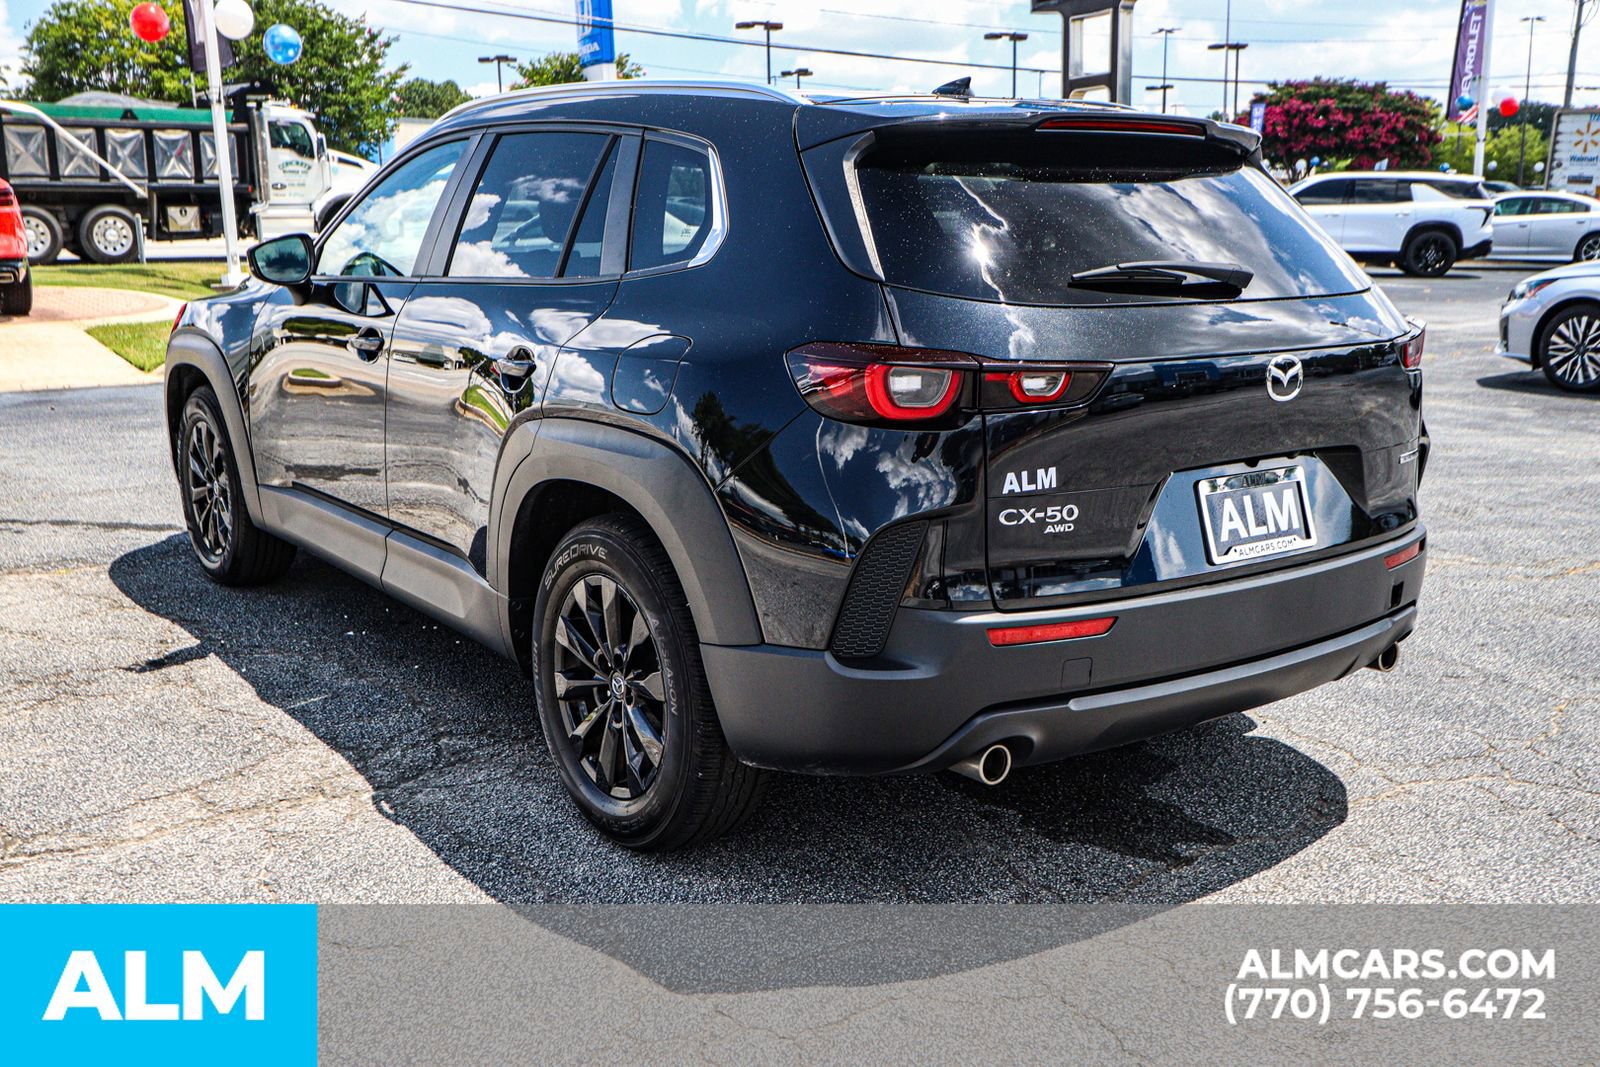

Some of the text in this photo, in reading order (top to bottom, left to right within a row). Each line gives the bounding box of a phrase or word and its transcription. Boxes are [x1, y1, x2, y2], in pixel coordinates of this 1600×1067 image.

[1002, 466, 1057, 495] ALM
[998, 504, 1079, 526] CX-50
[1220, 488, 1300, 543] ALM
[1043, 523, 1075, 534] AWD
[1238, 540, 1294, 557] ALMCARS.COM
